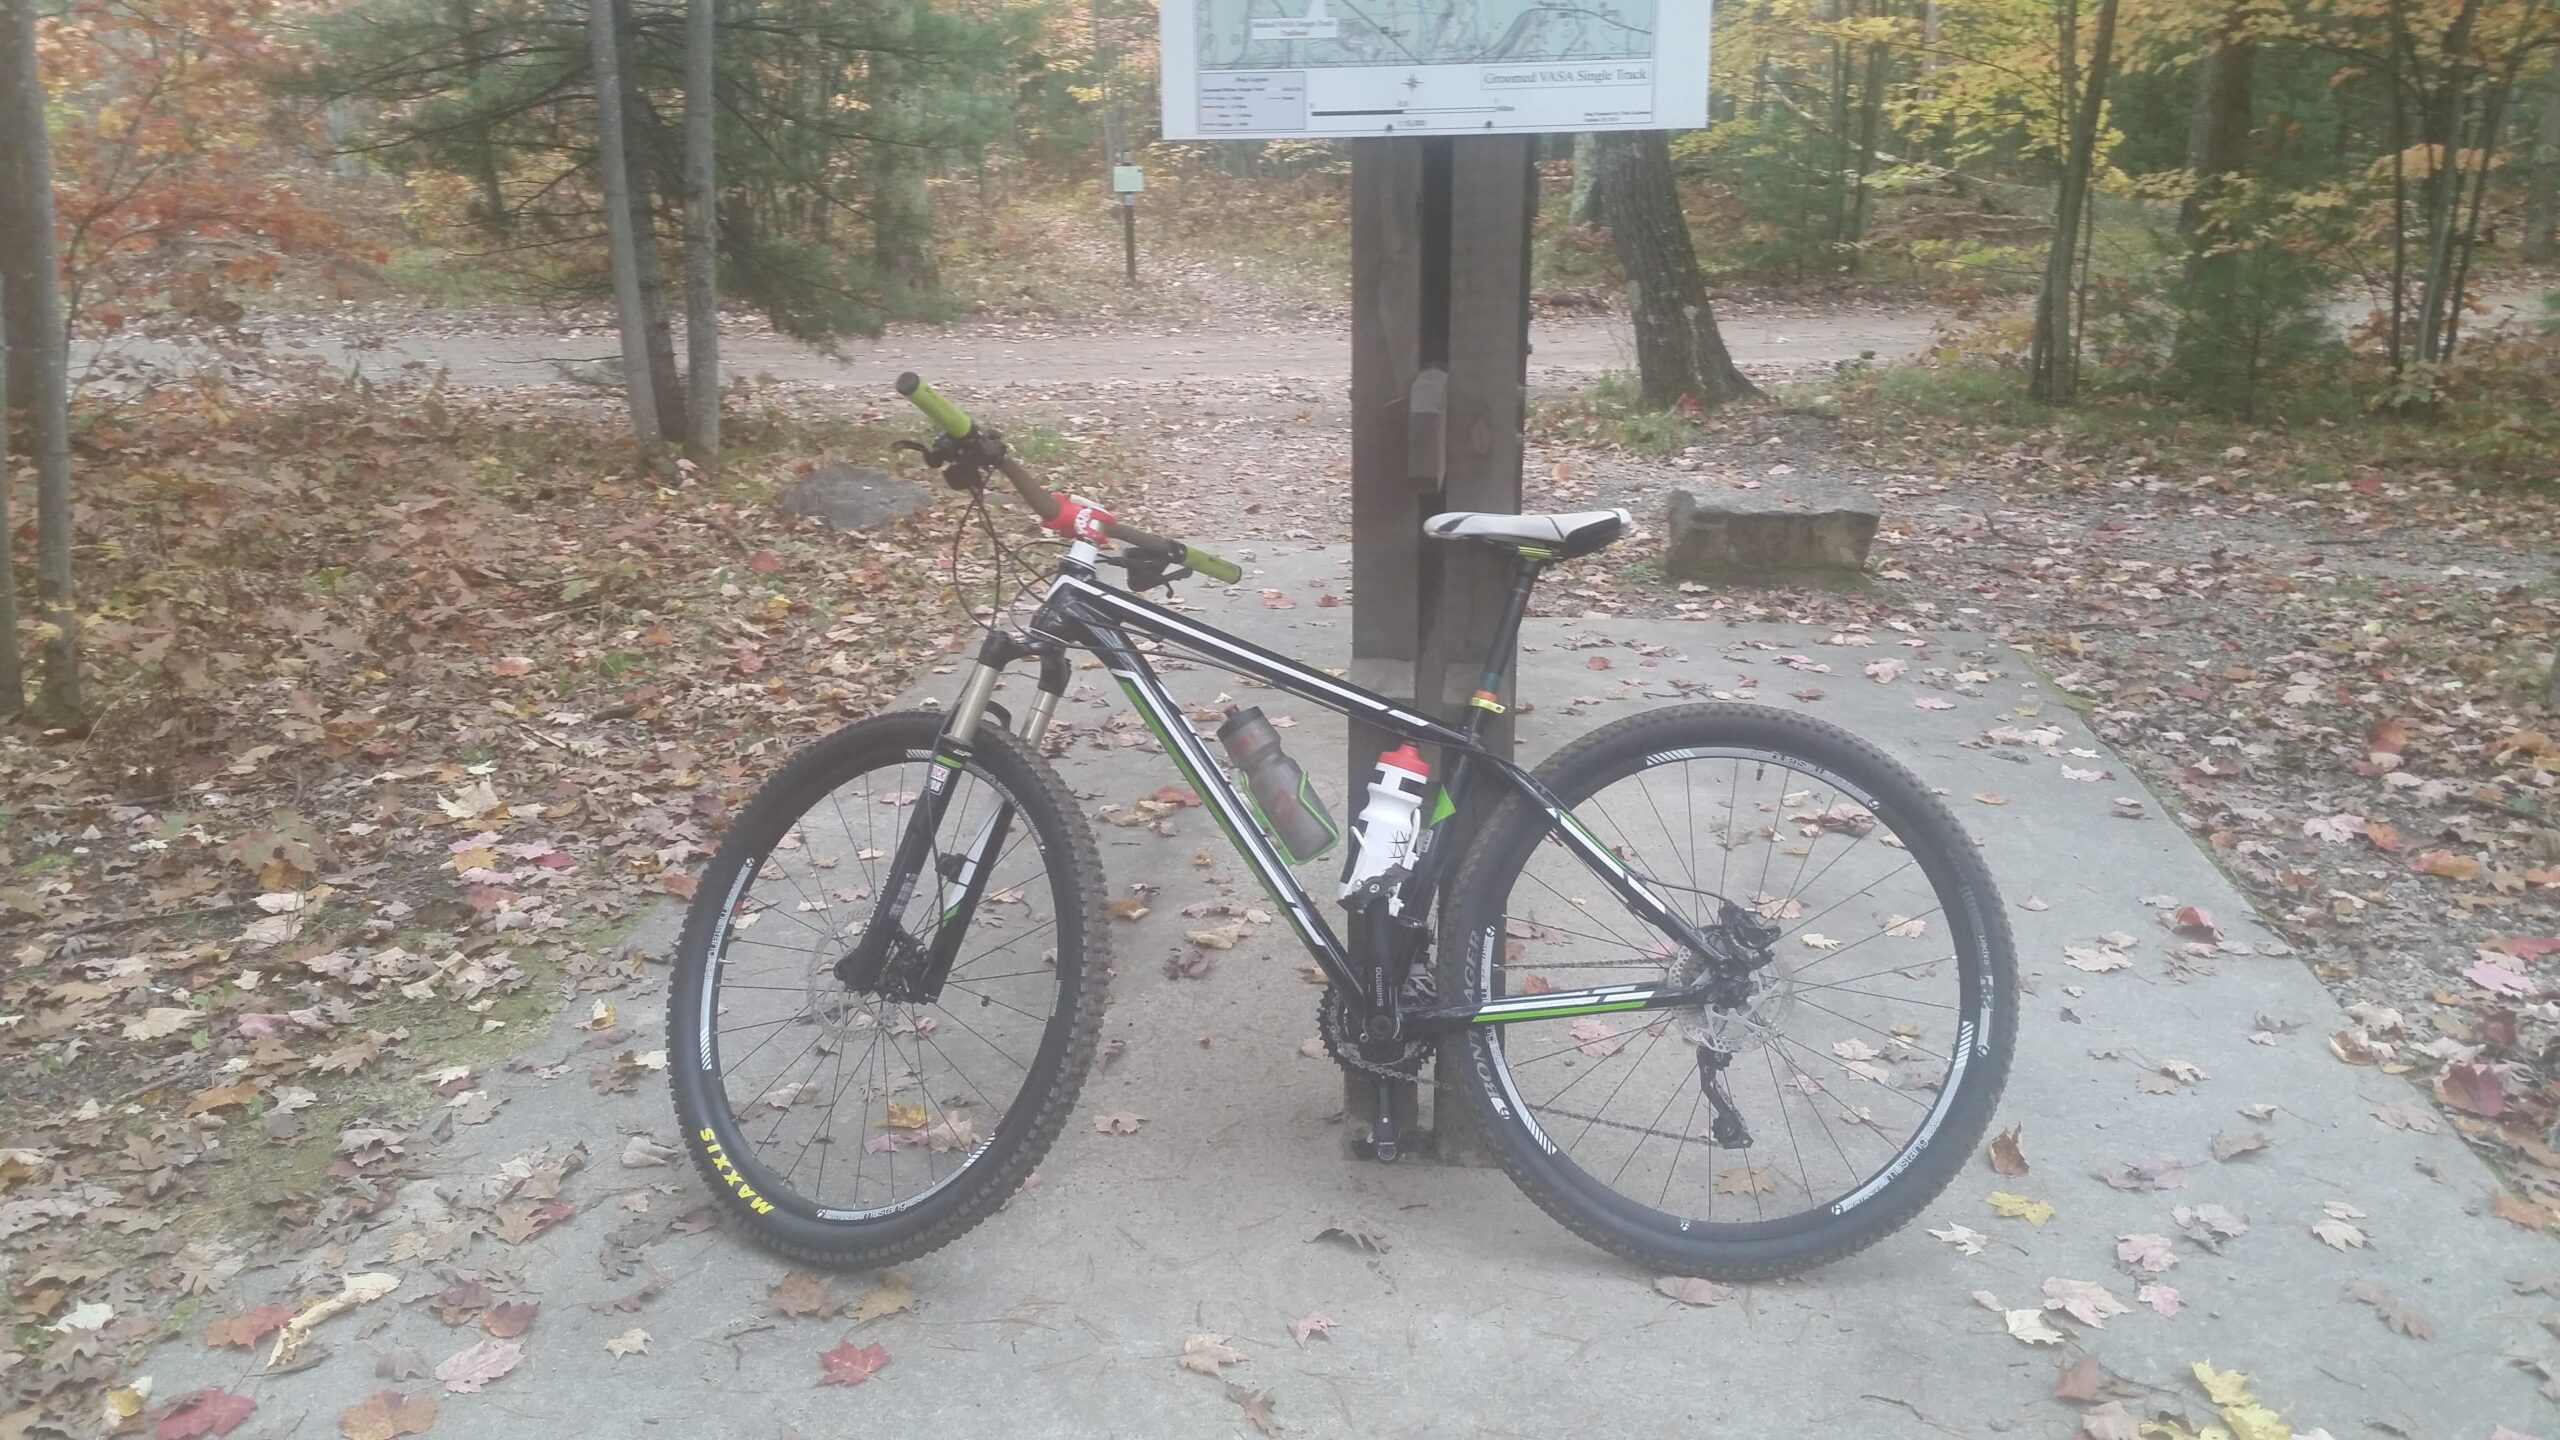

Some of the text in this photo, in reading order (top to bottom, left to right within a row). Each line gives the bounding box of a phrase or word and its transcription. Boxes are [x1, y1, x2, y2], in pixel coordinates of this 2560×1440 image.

[1483, 68, 1647, 85] Groomed VASA Single Track
[699, 1127, 776, 1215] MAXXIS
[1884, 1136, 1928, 1183] mustang
[862, 1200, 907, 1220] mustang
